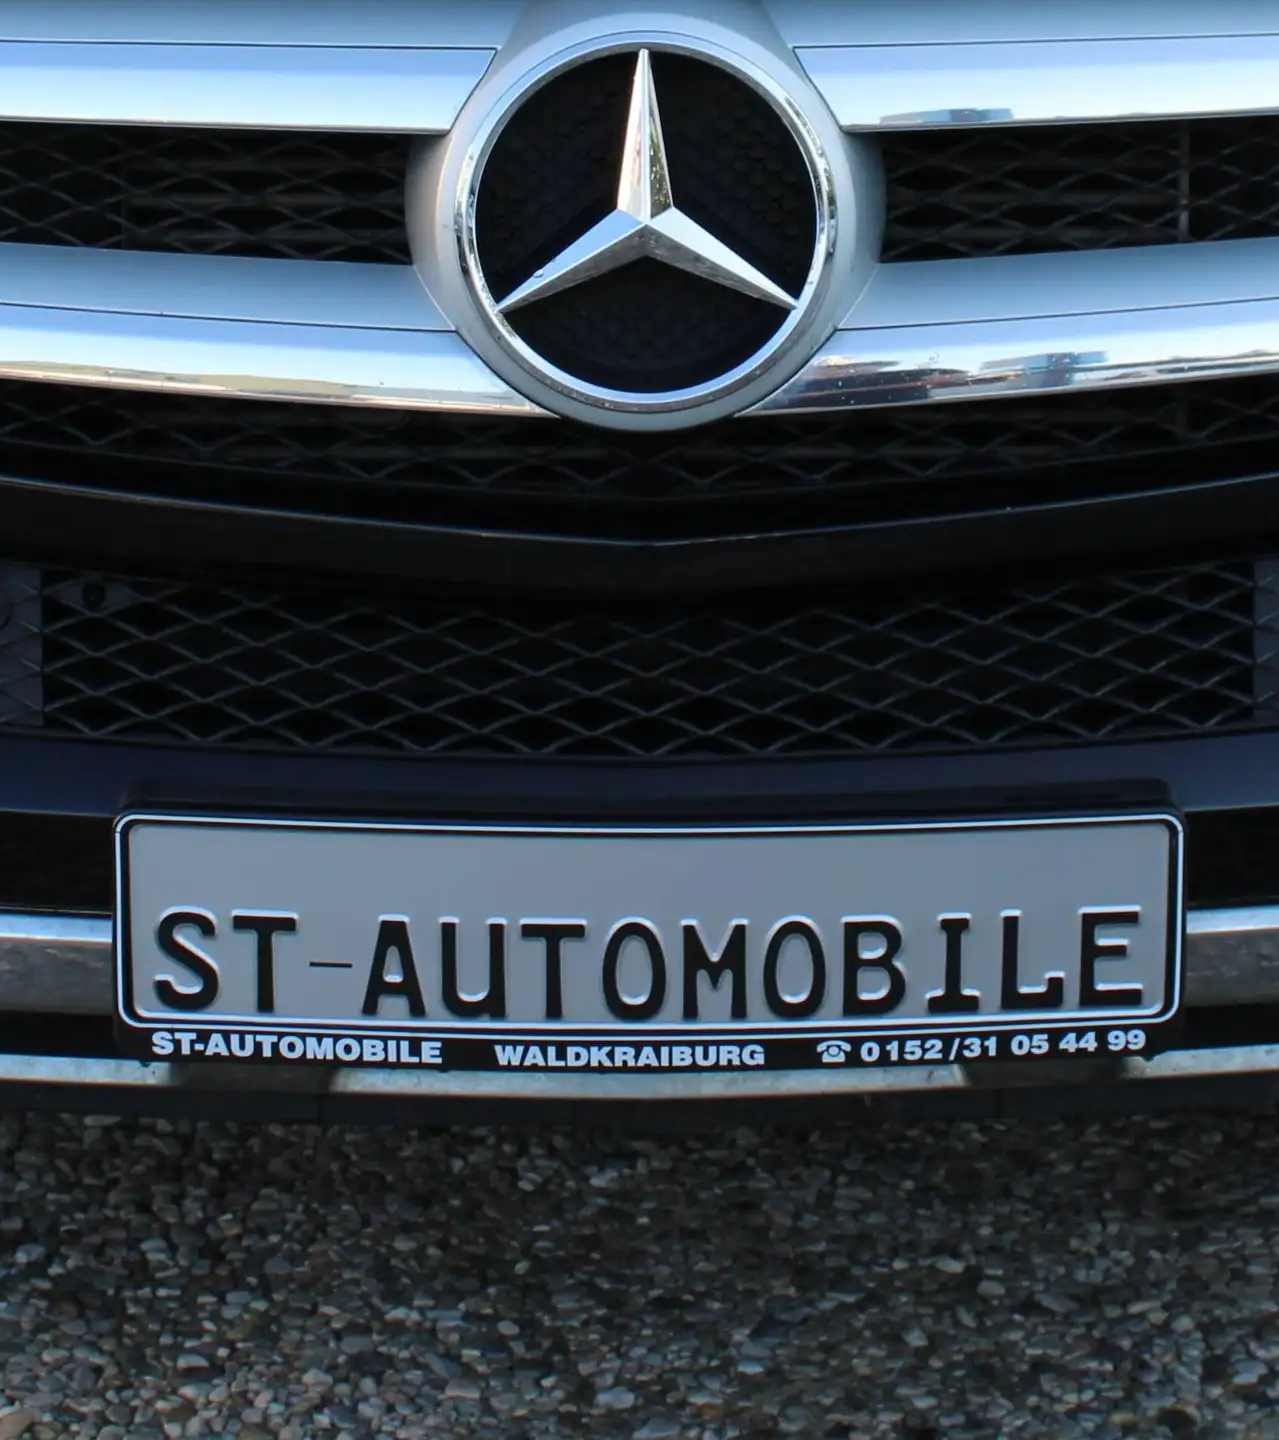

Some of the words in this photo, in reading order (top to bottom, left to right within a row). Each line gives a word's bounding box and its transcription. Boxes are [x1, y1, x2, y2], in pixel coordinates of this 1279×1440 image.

[151, 904, 1146, 1021] ST-AUTOMOBILE
[151, 1030, 444, 1064] ST-AUTOMOBILE
[494, 1043, 766, 1067] WALDKRAIBURG
[1010, 1033, 1050, 1056] 05
[1058, 1031, 1098, 1053] 44
[1107, 1029, 1147, 1052] 99
